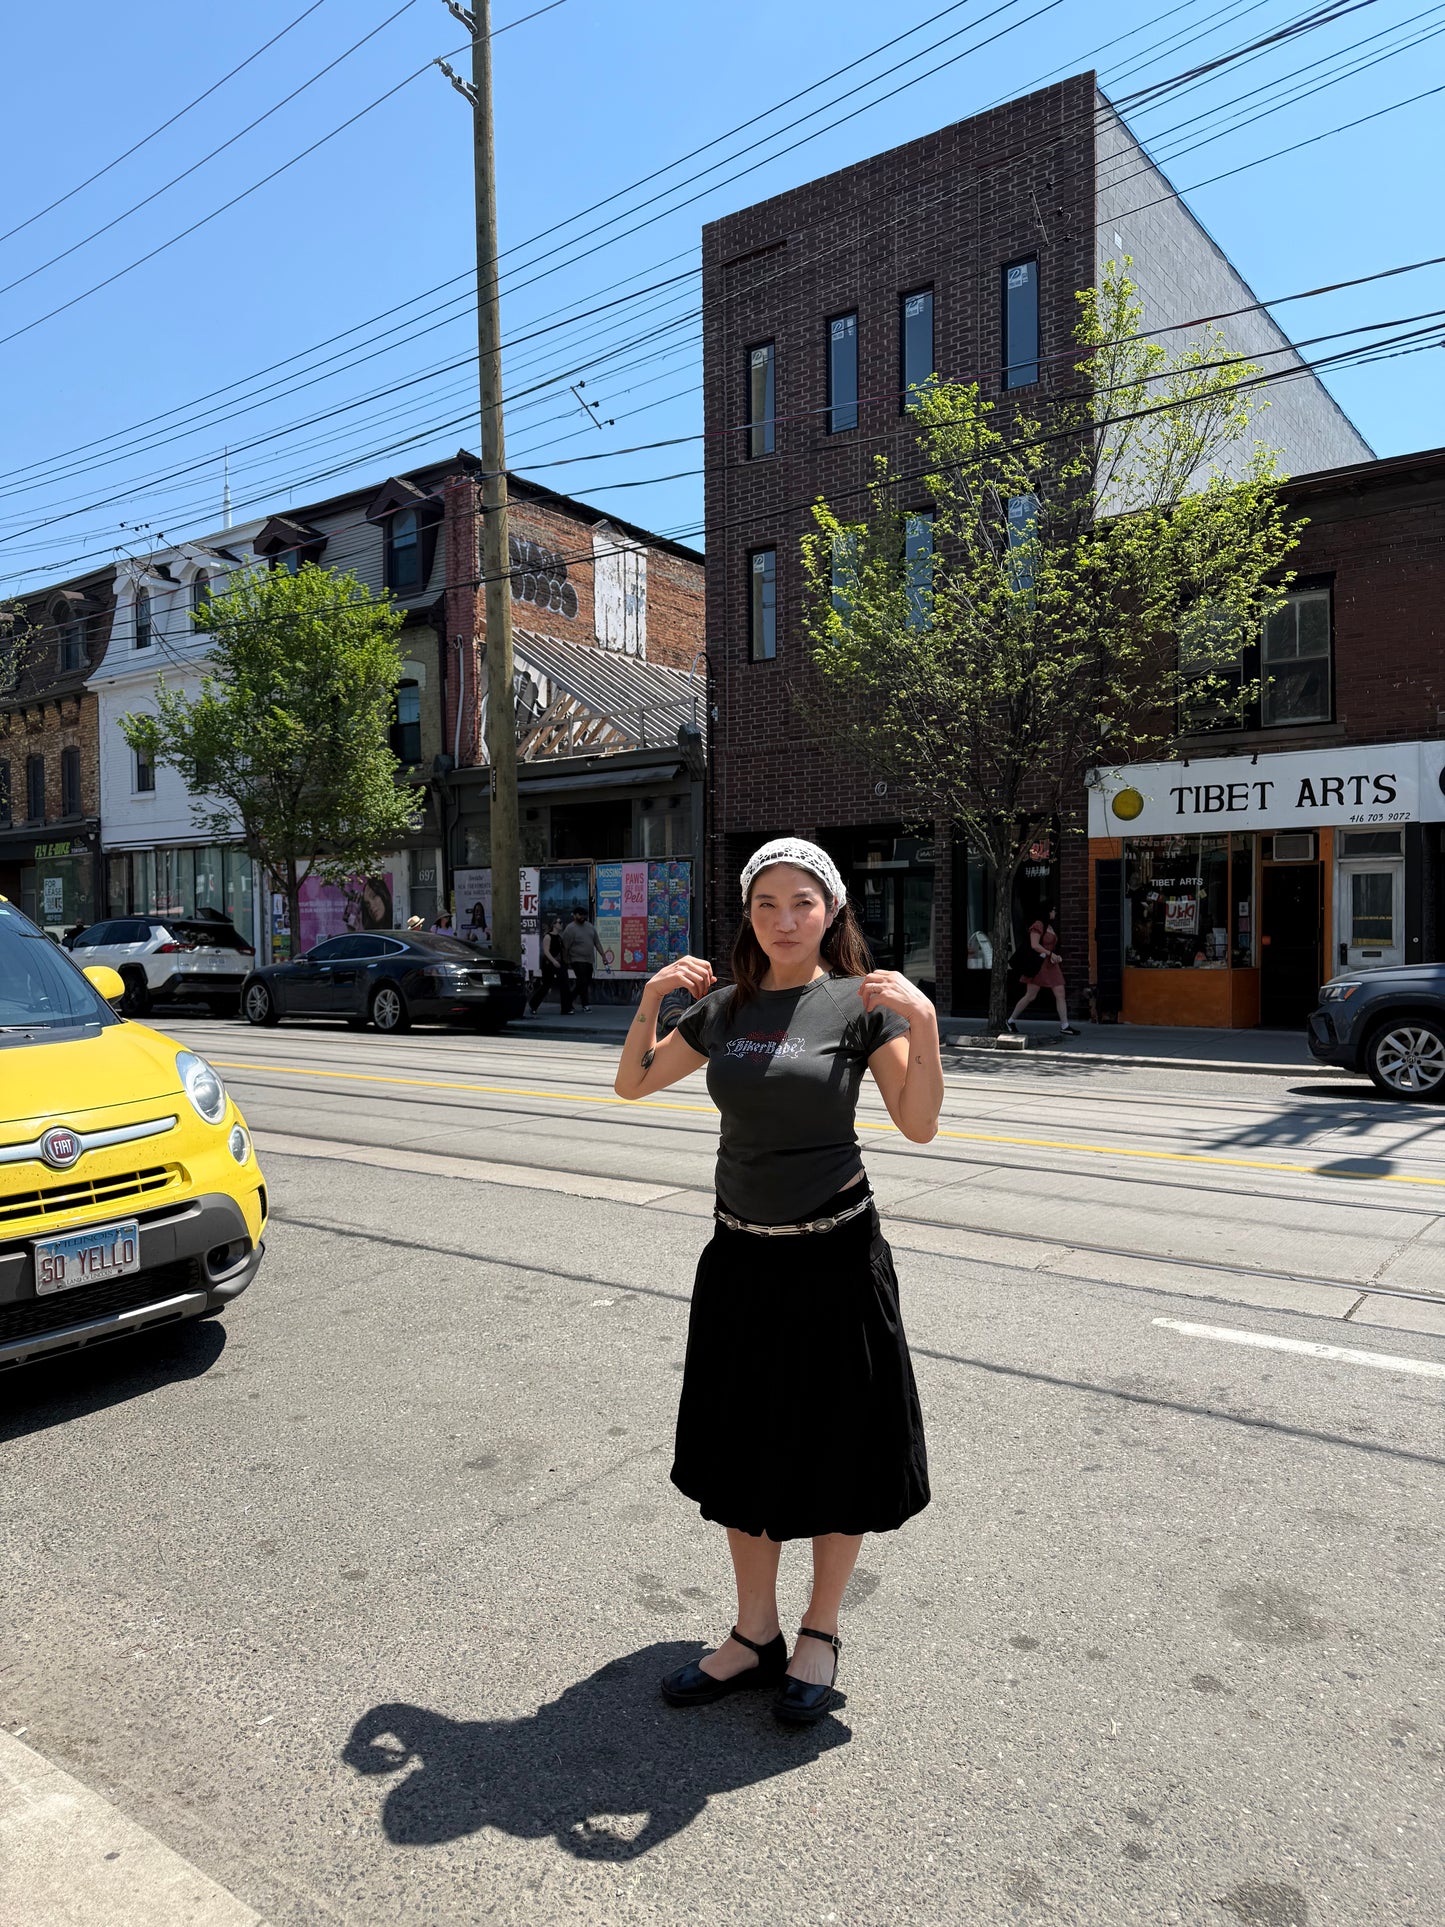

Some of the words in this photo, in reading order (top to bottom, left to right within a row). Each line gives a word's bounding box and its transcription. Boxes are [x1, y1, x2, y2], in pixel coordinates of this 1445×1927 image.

[1169, 781, 1275, 814] TIBET
[1295, 774, 1397, 808] ARTS
[1349, 814, 1364, 823] 416
[1367, 813, 1384, 822] 703
[1388, 812, 1411, 821] 9072
[34, 844, 48, 858] FLY
[48, 841, 71, 856] E-BIKE
[418, 869, 436, 881] 697
[625, 872, 645, 884] PAWS
[45, 880, 56, 888] FOR
[1150, 878, 1176, 887] TIBET
[1179, 877, 1203, 886] ARTS
[45, 887, 62, 896] LEASE
[624, 890, 643, 903] Pets
[53, 1139, 72, 1155] FIAT
[64, 1230, 114, 1248] ILLINOIS
[42, 1254, 65, 1284] SO
[77, 1238, 134, 1276] YELLO
